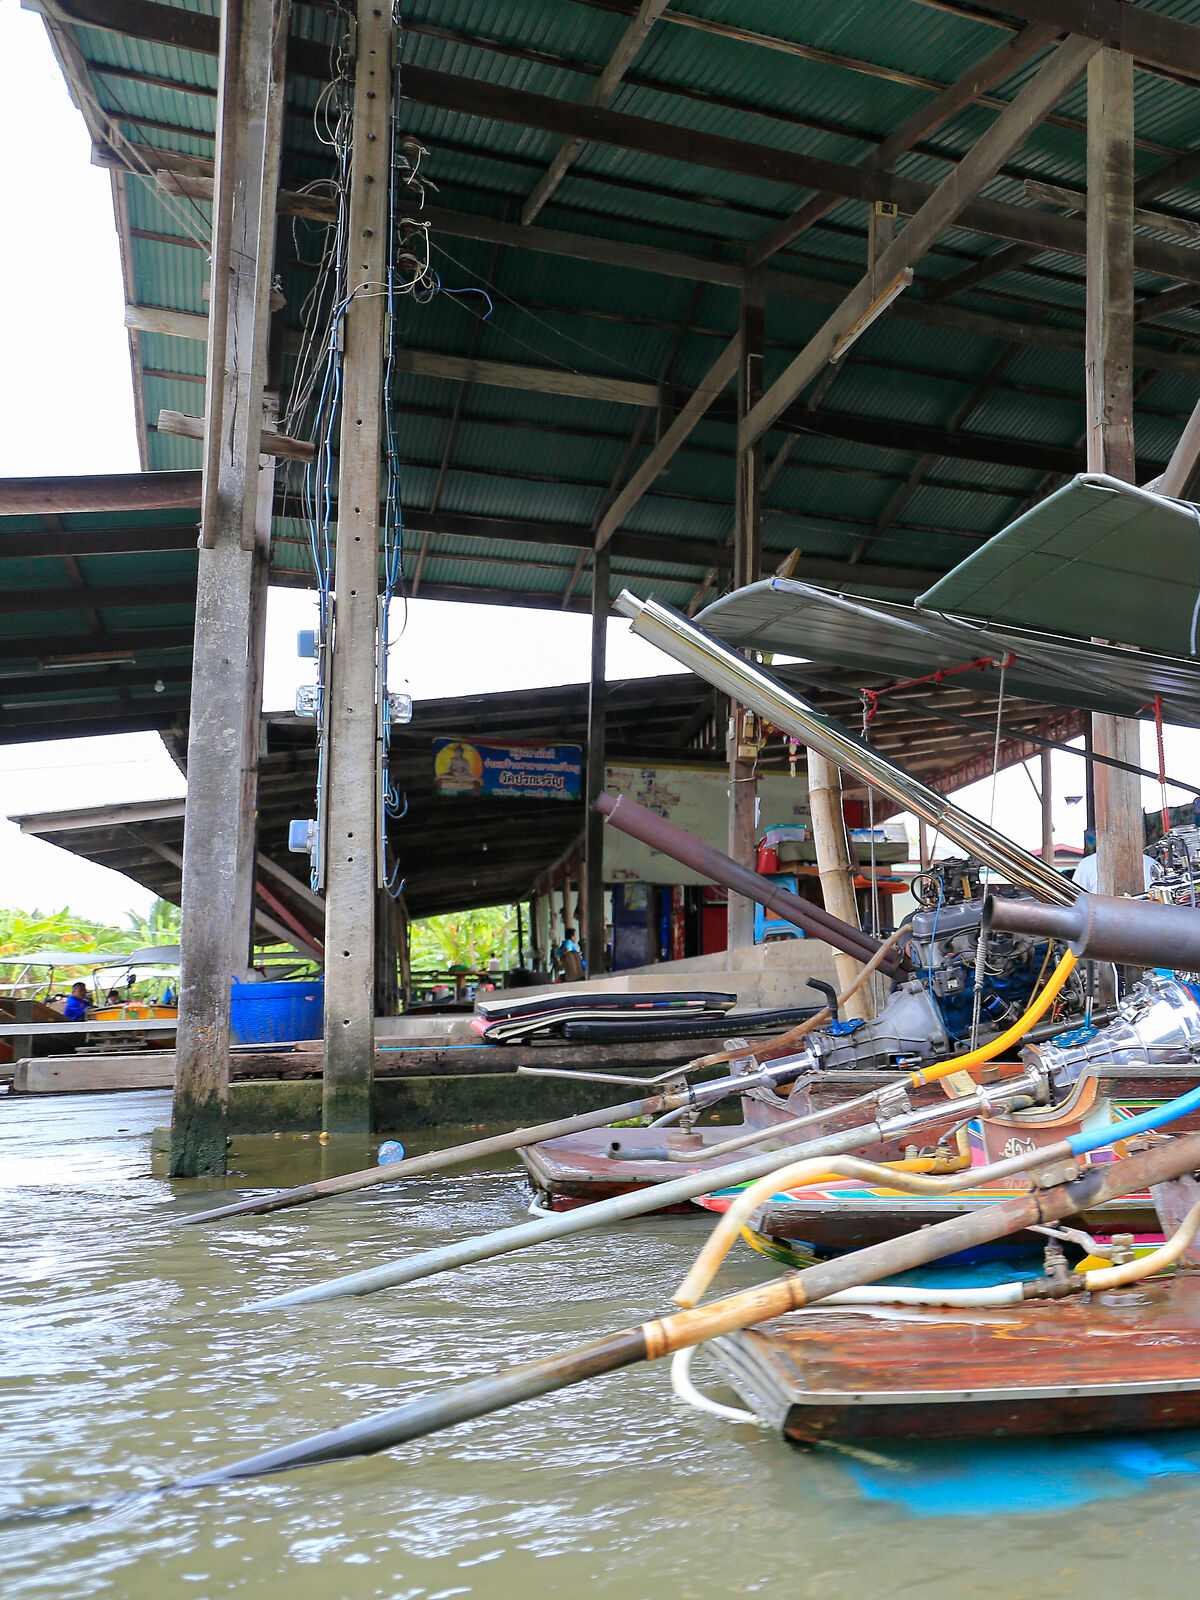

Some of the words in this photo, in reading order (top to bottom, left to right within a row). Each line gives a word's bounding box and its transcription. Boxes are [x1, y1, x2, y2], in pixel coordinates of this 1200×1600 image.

[500, 770, 565, 789] วัดปรกเจริญ
